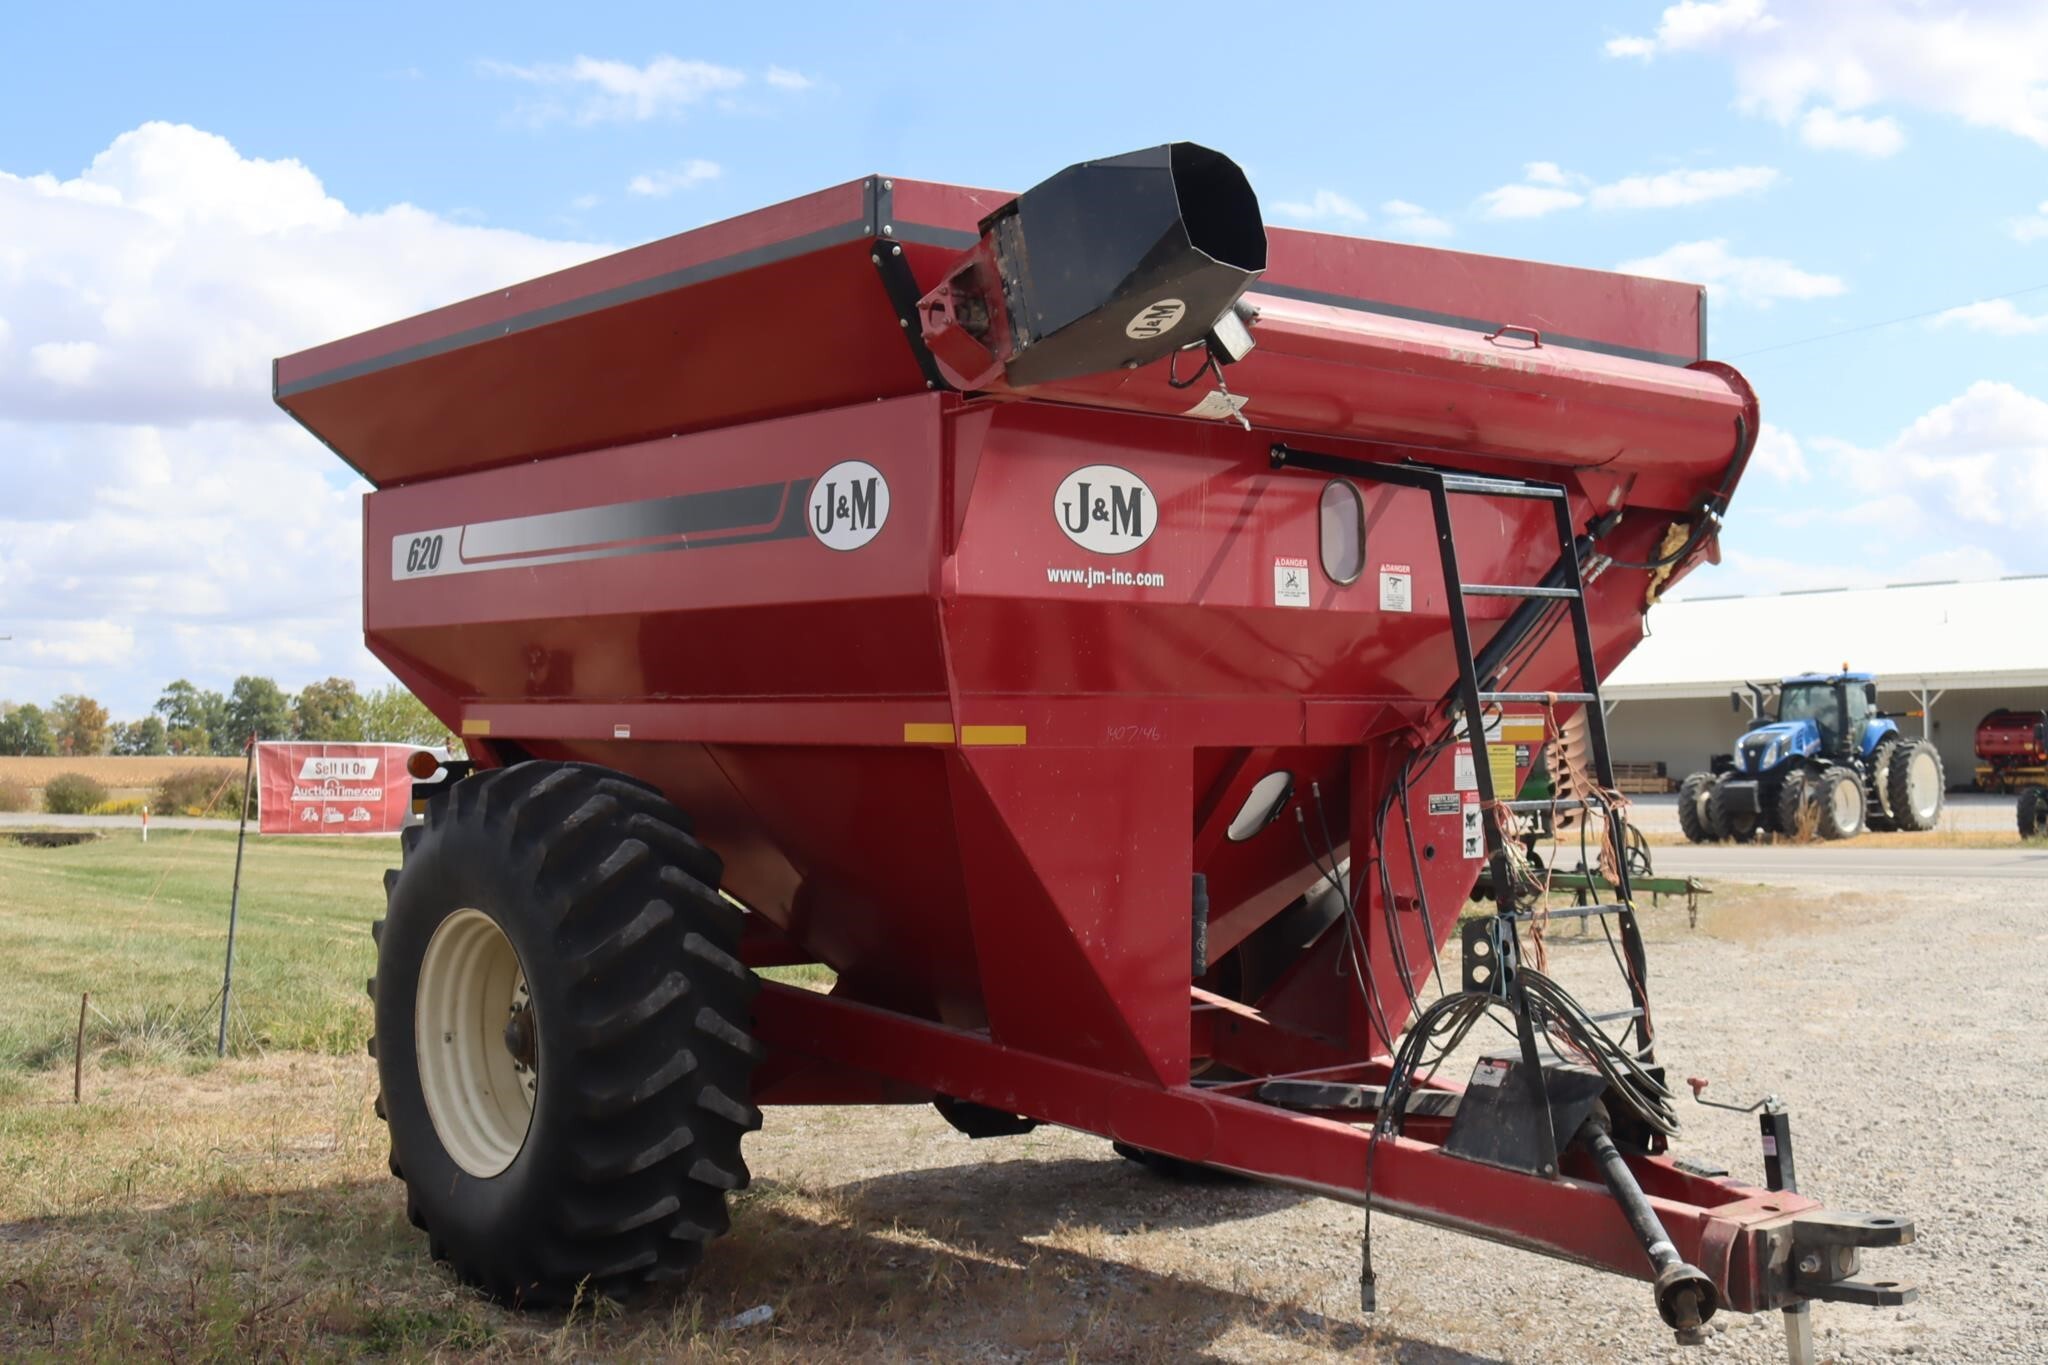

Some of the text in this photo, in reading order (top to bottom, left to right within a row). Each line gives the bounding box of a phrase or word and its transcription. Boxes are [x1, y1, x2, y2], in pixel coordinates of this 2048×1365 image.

[1132, 303, 1182, 338] J&M
[814, 477, 878, 535] J&M
[1062, 481, 1144, 538] J&M
[406, 534, 443, 573] 620
[1280, 559, 1308, 567] DANGER
[1047, 566, 1165, 589] www.jm-inc.com
[1385, 565, 1411, 573] DANGER
[315, 762, 366, 775] Sell It On
[292, 784, 382, 798] AuctionTime.com
